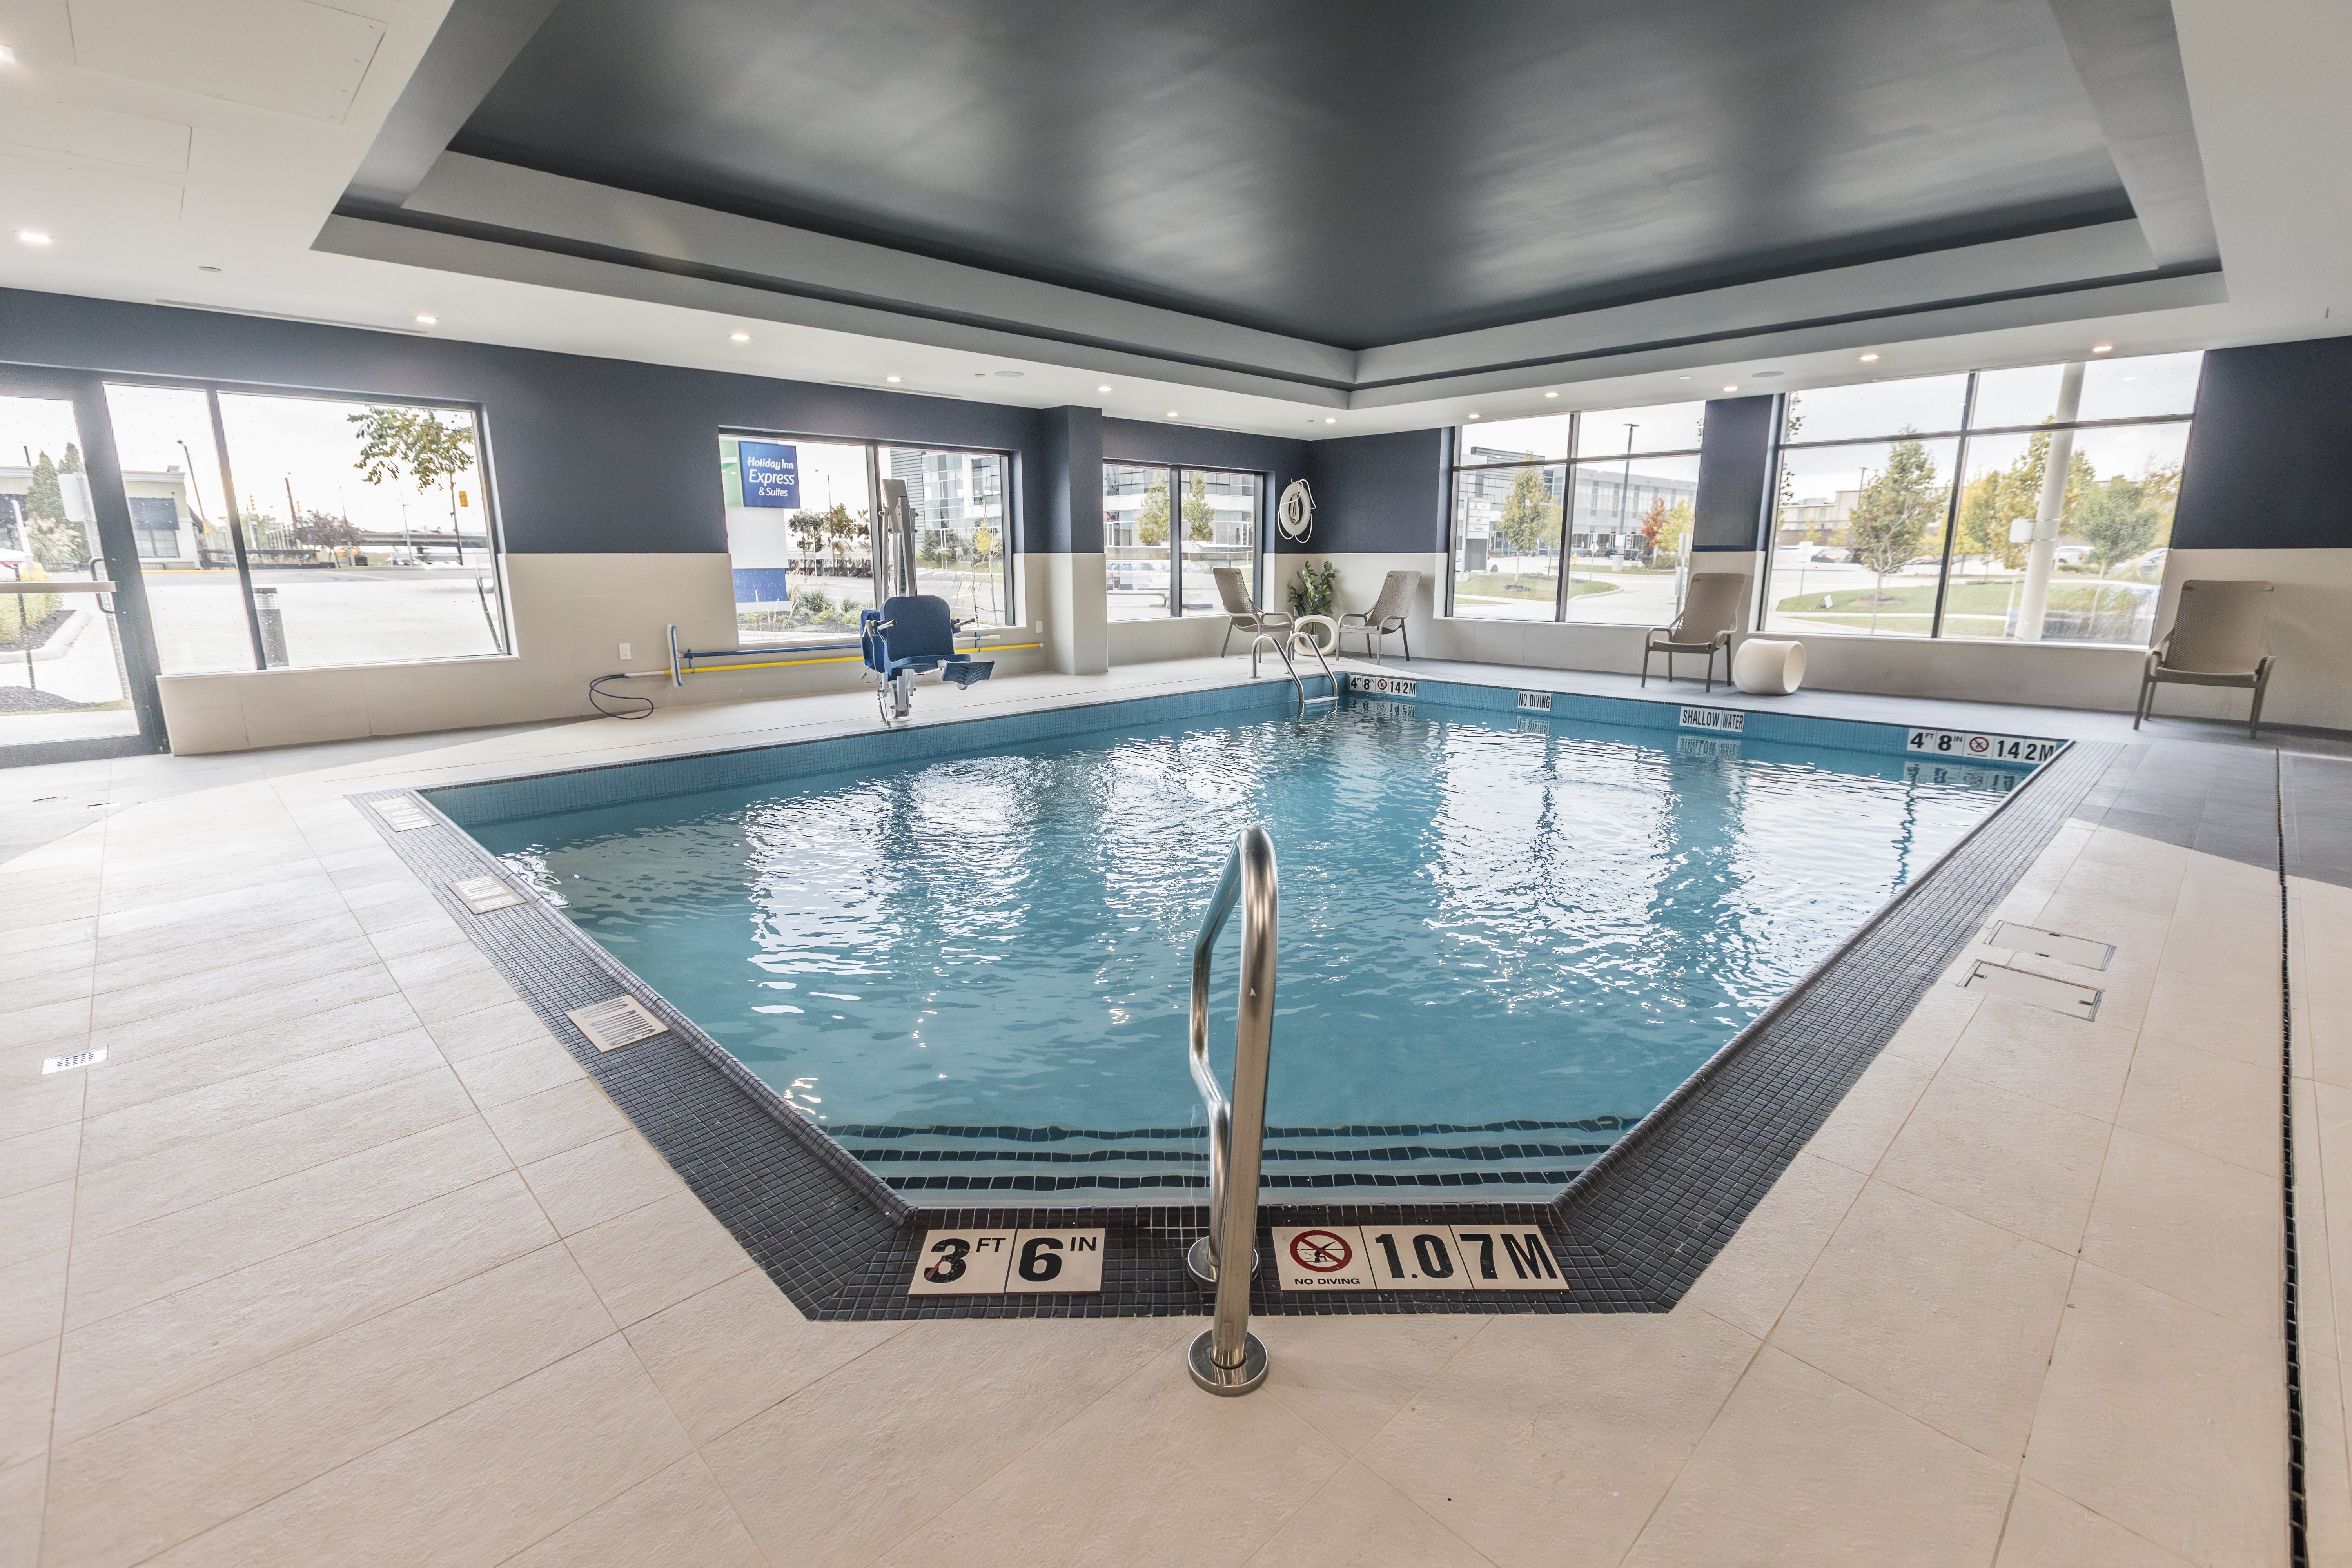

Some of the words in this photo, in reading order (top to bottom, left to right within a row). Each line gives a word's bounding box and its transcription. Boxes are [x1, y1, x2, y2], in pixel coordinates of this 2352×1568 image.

[747, 456, 780, 470] Holiday
[782, 459, 794, 469] Inn
[749, 469, 794, 486] Express
[759, 487, 764, 495] &
[766, 487, 788, 497] Suites
[1519, 693, 1527, 706] NO
[1530, 694, 1550, 708] DIVING
[1683, 710, 1720, 727] SHALLOW
[1723, 713, 1744, 730] WATER
[455, 876, 508, 900] SHALLOW
[474, 895, 518, 911] AREA
[580, 998, 628, 1020] NO
[589, 1009, 656, 1046] DIVING
